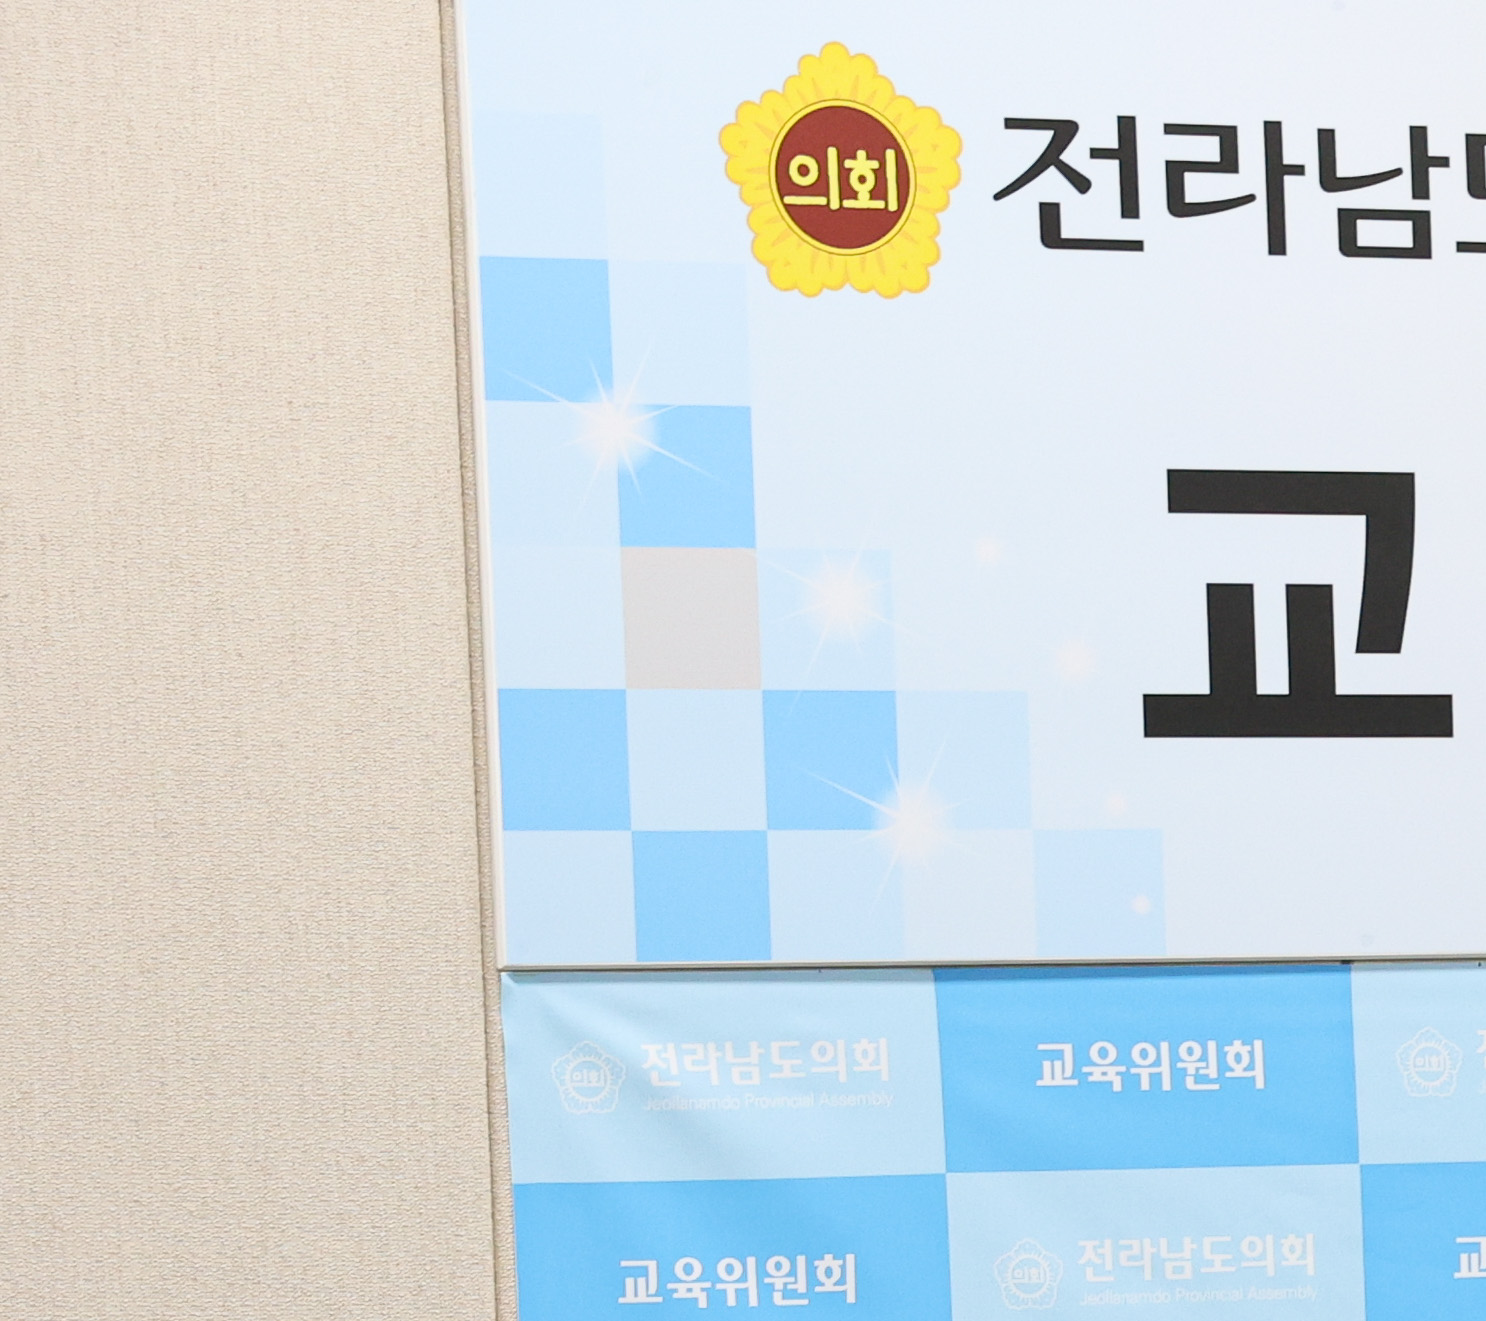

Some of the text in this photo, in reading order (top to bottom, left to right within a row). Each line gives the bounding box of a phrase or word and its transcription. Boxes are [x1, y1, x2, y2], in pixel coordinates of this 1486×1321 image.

[783, 146, 899, 212] 의회
[642, 1039, 889, 1087] 전라남도의회
[1038, 1041, 1265, 1092] 교육위원회
[620, 1255, 856, 1309] 교육위원회
[1080, 1235, 1315, 1282] 전라남도의회
